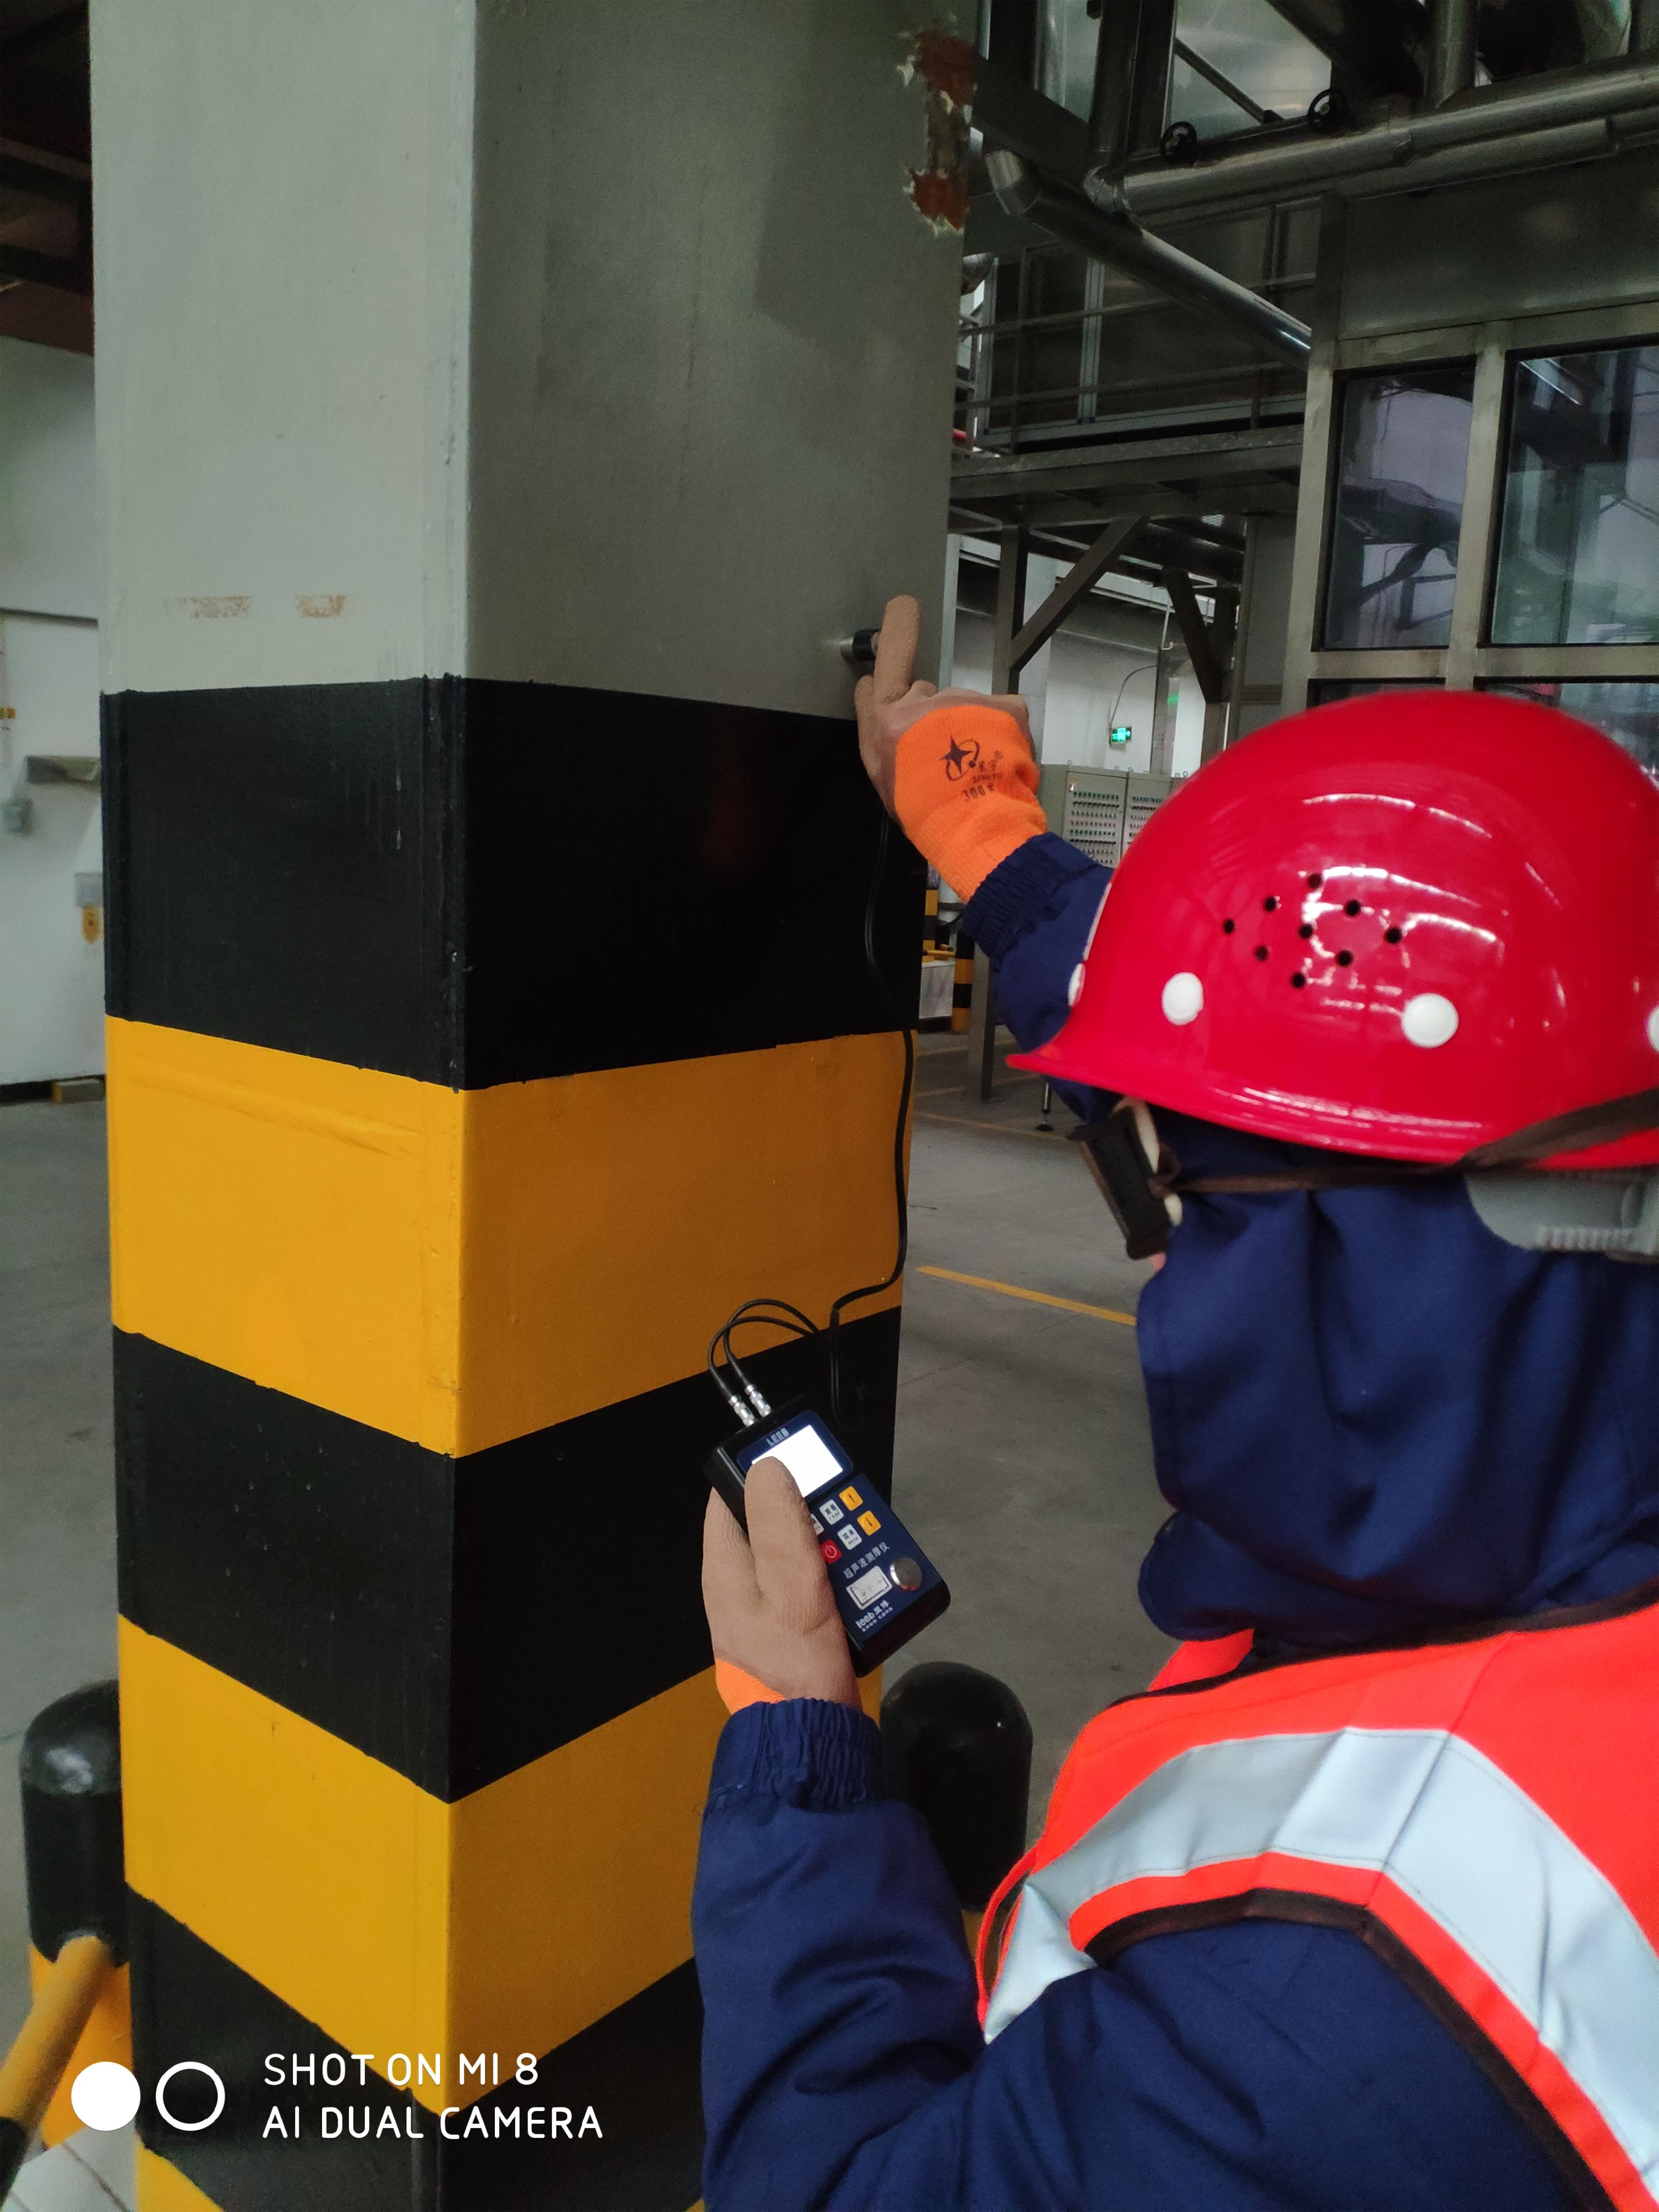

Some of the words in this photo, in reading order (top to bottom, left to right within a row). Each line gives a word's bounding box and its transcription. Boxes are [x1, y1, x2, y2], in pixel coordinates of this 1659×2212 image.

[766, 1427, 789, 1447] LEEB
[843, 1542, 890, 1579] 超声波测厚仪
[855, 1612, 875, 1629] leeb
